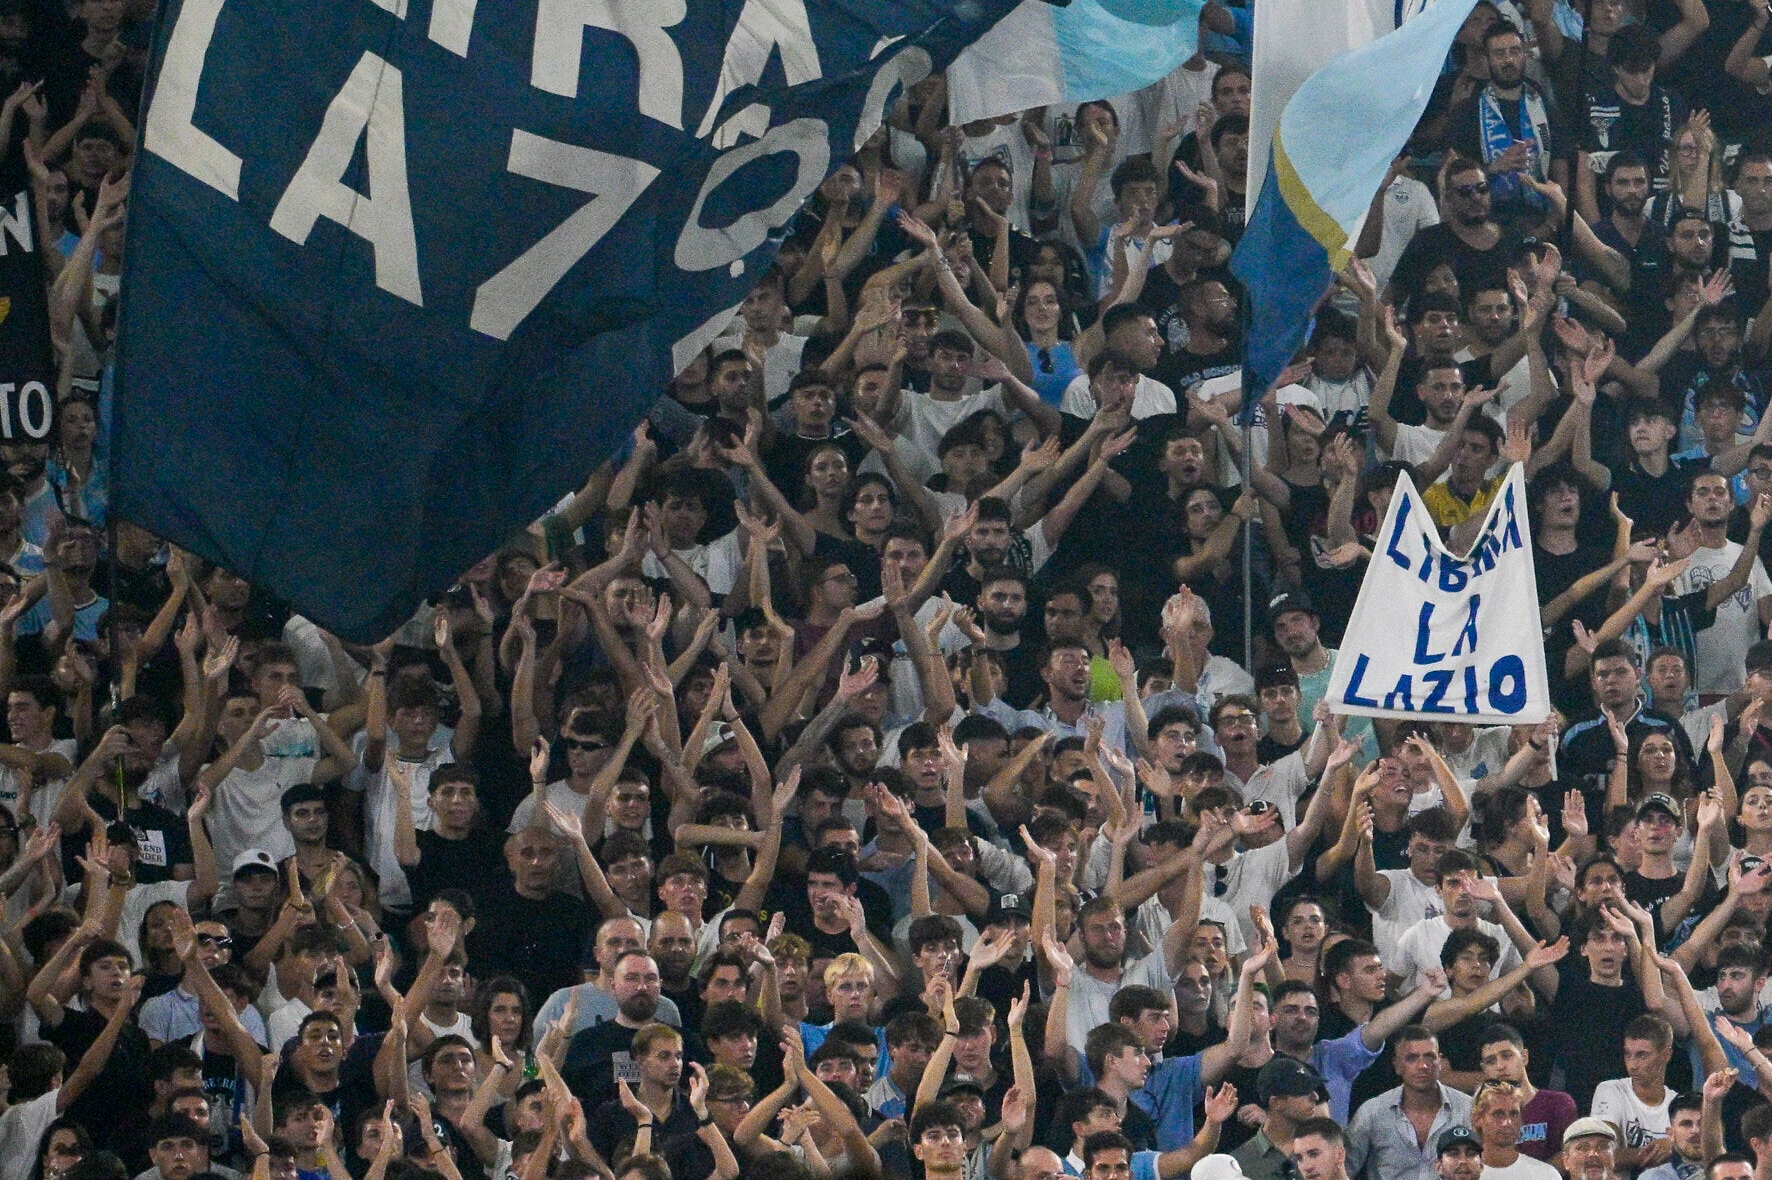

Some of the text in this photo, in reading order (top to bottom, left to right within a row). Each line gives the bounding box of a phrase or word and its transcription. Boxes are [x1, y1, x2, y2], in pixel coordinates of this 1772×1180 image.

[0, 380, 52, 439] TO
[1412, 593, 1482, 666] LA
[1342, 653, 1528, 716] LAZIO
[434, 1123, 444, 1137] 2
